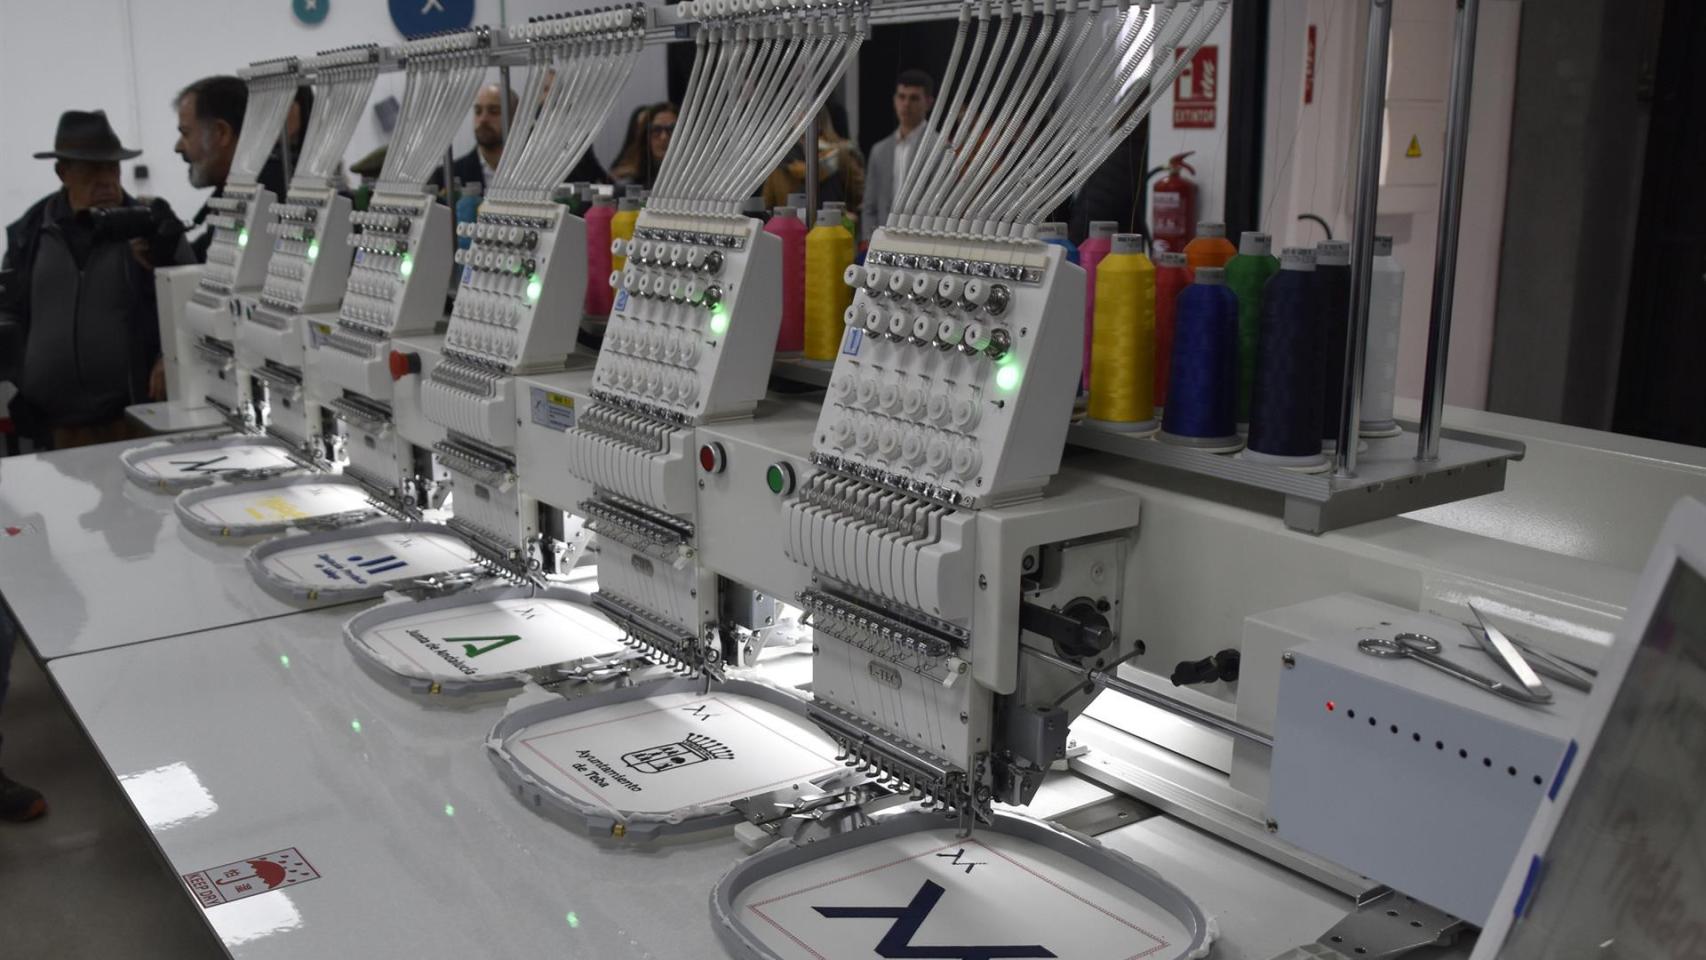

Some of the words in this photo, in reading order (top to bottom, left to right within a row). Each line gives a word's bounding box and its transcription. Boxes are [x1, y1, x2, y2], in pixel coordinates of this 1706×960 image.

[1174, 109, 1214, 122] EXTINTOR
[571, 763, 588, 772] de
[585, 771, 610, 788] Teba
[575, 750, 642, 792] Ayuntamiento
[187, 872, 209, 890] KEEP
[200, 889, 220, 905] DRY
